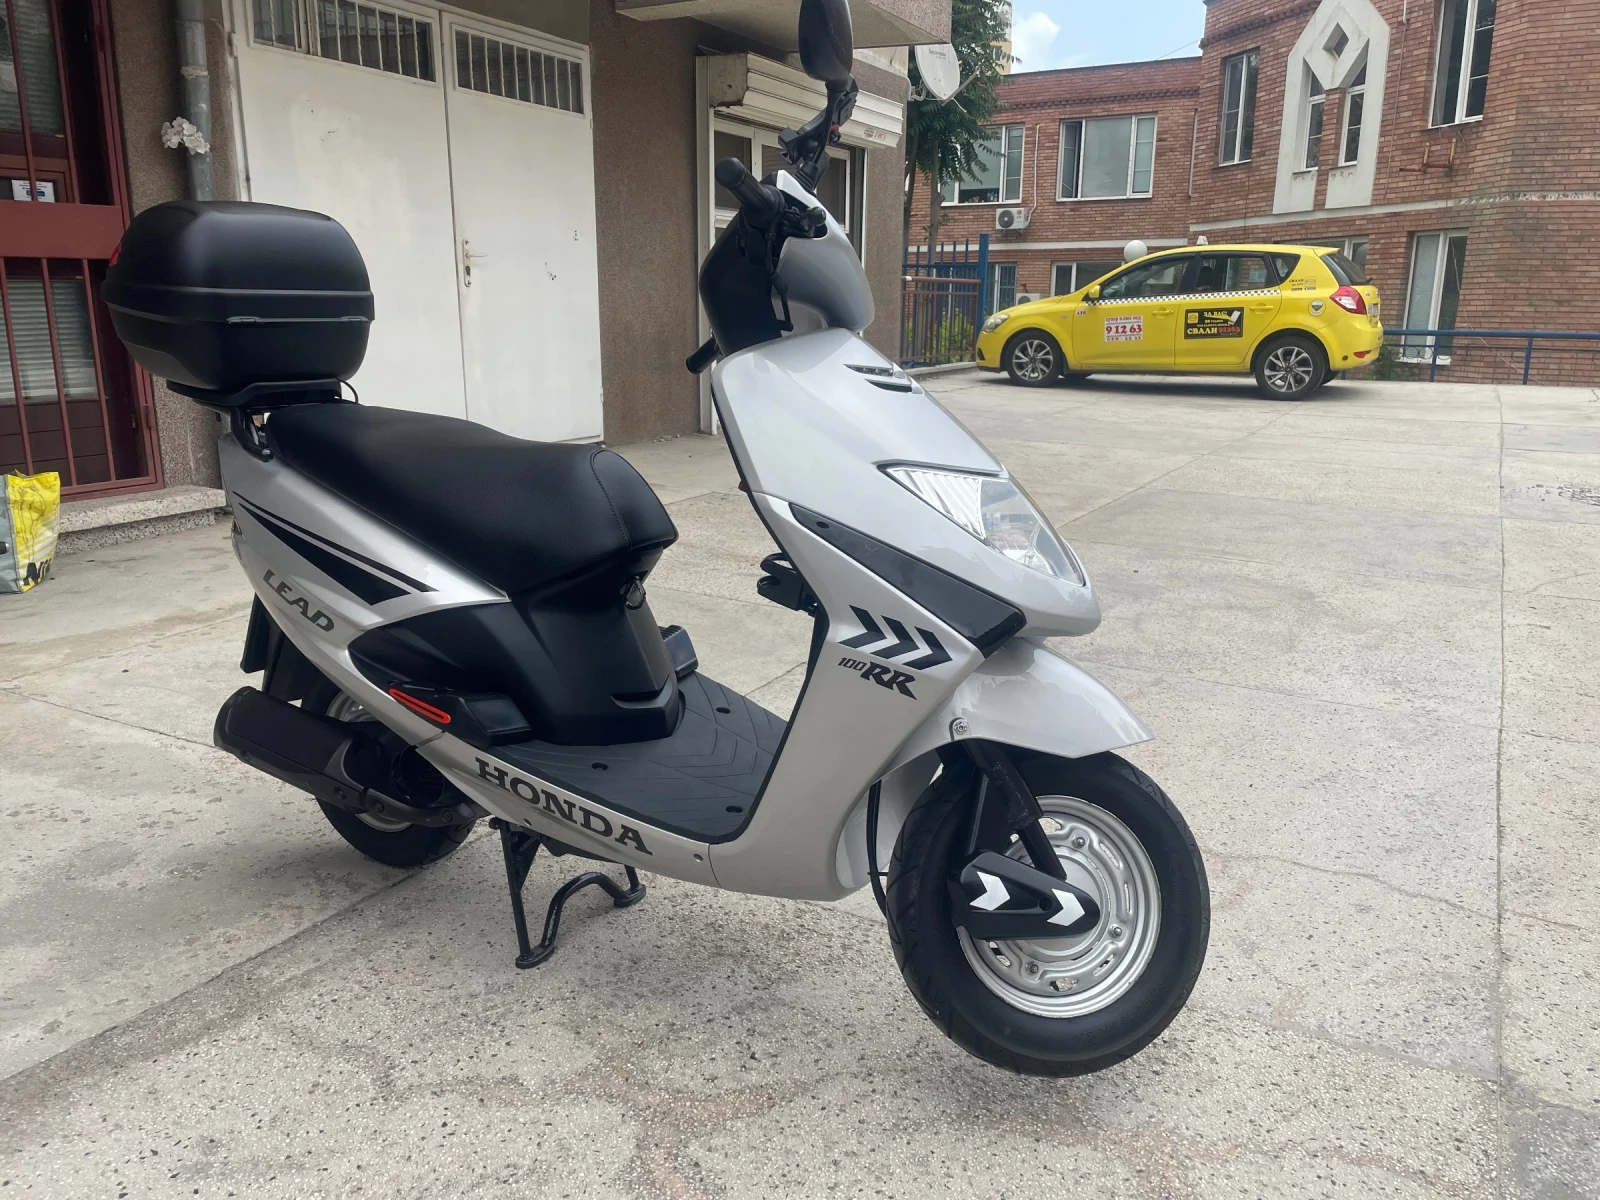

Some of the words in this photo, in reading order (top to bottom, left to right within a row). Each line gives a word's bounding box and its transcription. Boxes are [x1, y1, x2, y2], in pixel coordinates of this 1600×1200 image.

[262, 568, 335, 633] LEAD
[837, 656, 868, 672] 100
[474, 756, 653, 857] HONDA
